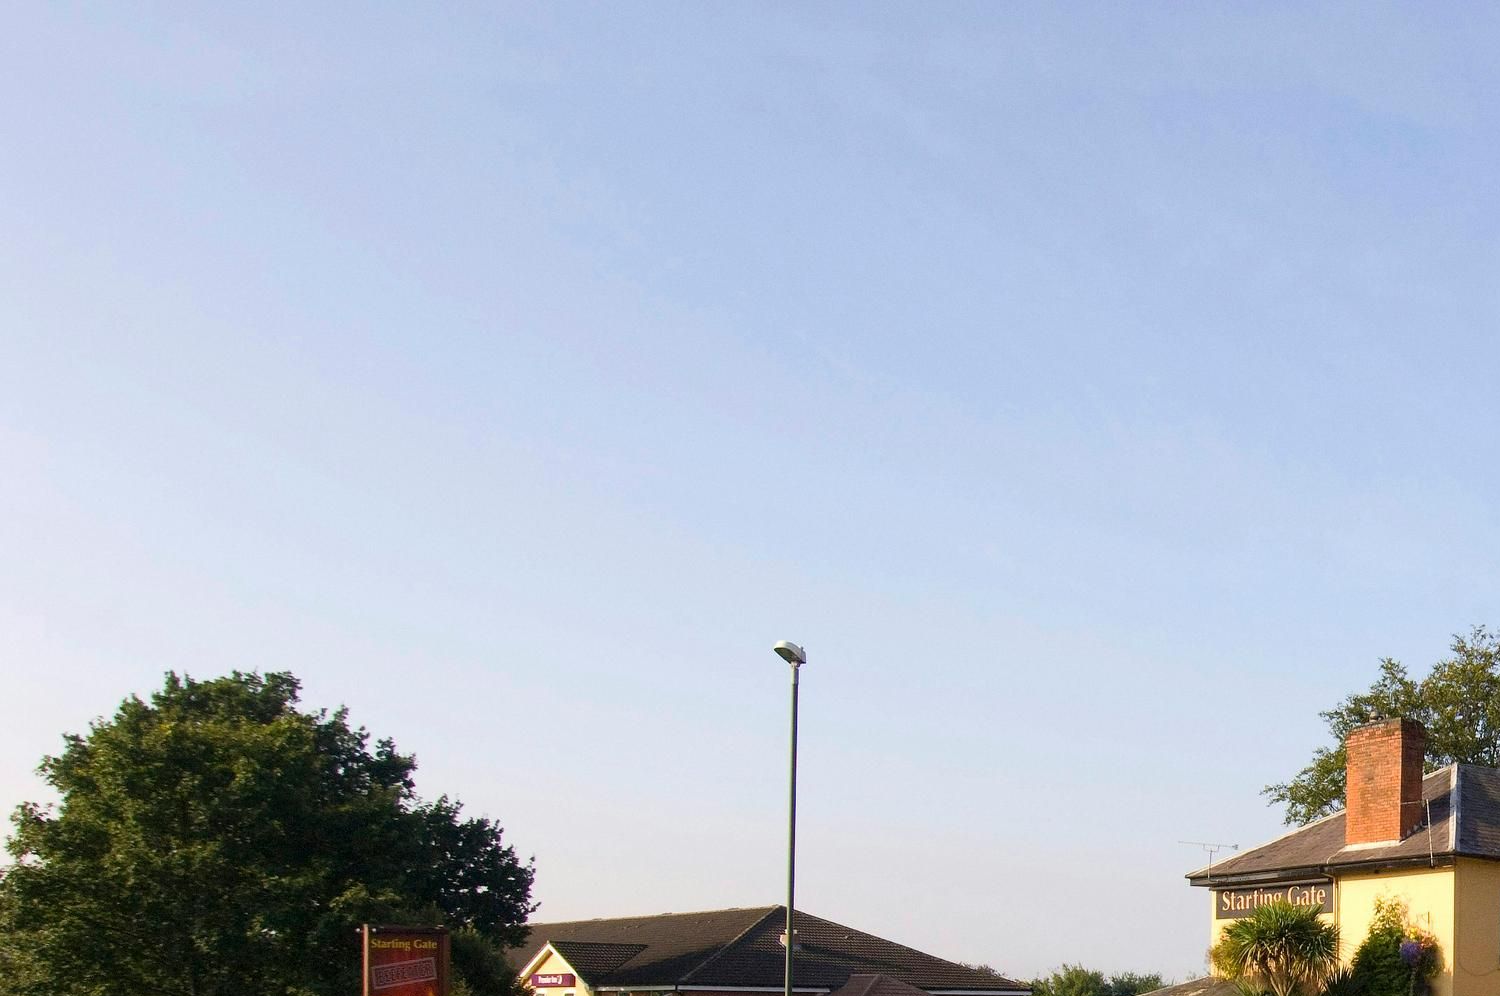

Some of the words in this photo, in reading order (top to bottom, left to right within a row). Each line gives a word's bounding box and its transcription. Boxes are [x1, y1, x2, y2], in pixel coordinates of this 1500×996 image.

[1222, 887, 1282, 911] Starting
[1287, 885, 1326, 907] Gate
[371, 939, 411, 951] Starting
[413, 939, 437, 949] Gate
